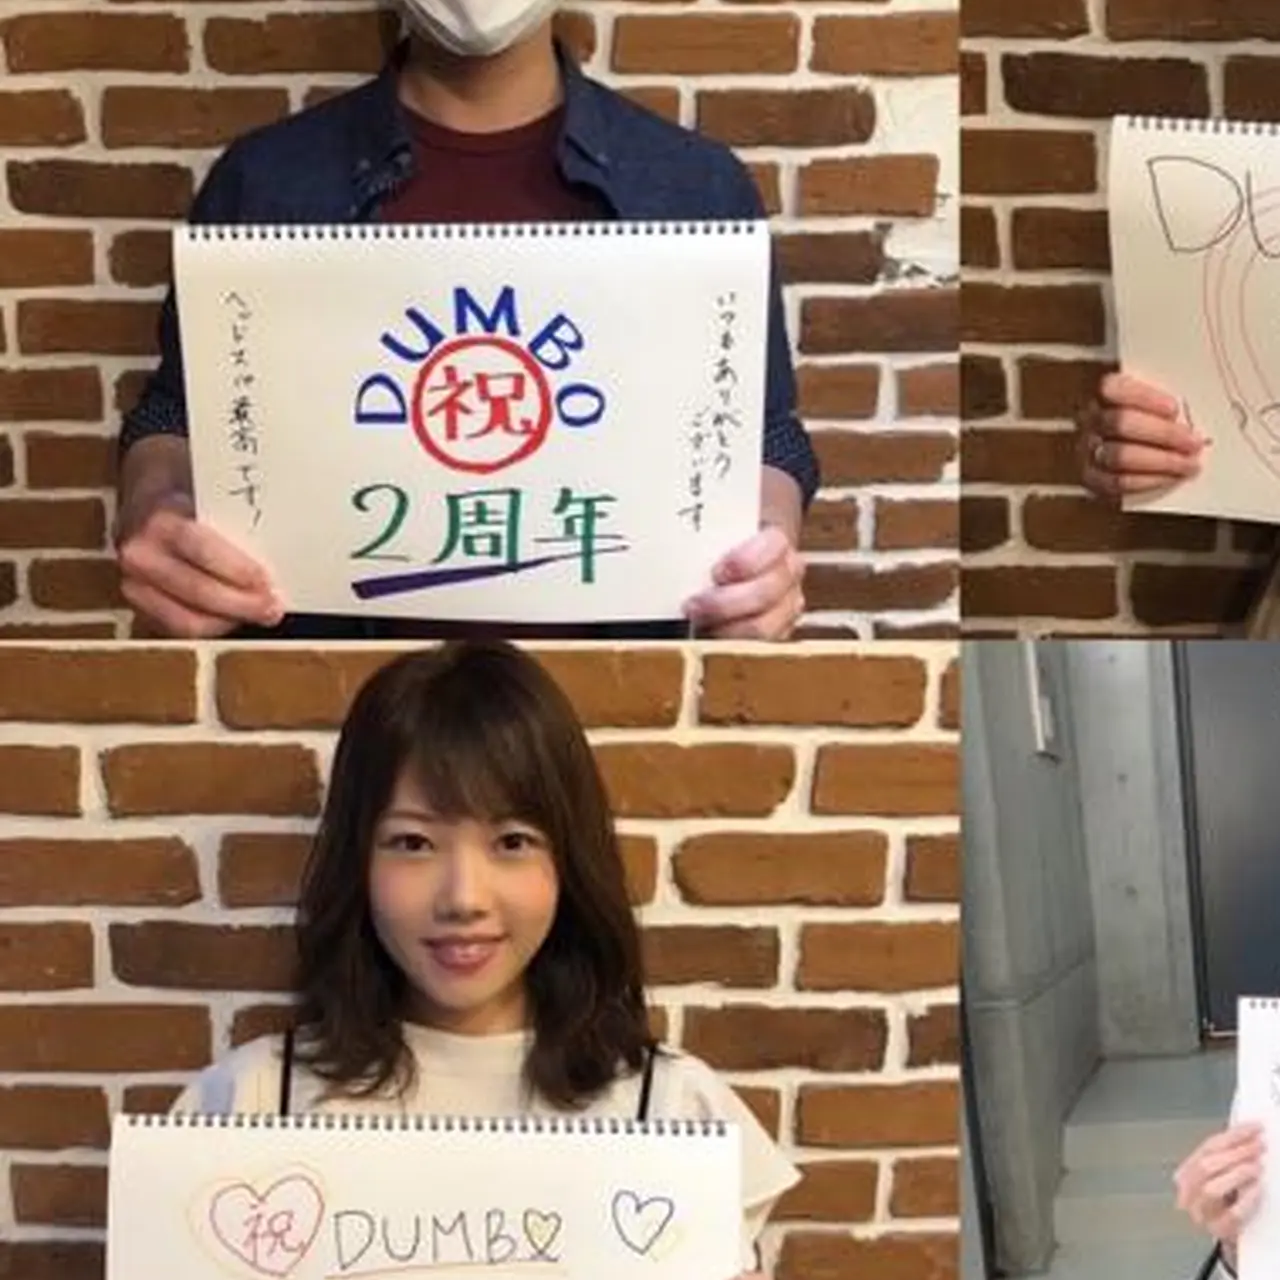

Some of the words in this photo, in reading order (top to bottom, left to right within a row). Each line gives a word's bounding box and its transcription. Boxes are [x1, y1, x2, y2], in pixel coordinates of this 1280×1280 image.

[355, 286, 606, 428] DUMBO
[428, 365, 532, 441] 祝
[351, 484, 630, 584] 2周年
[243, 1204, 305, 1262] 祝
